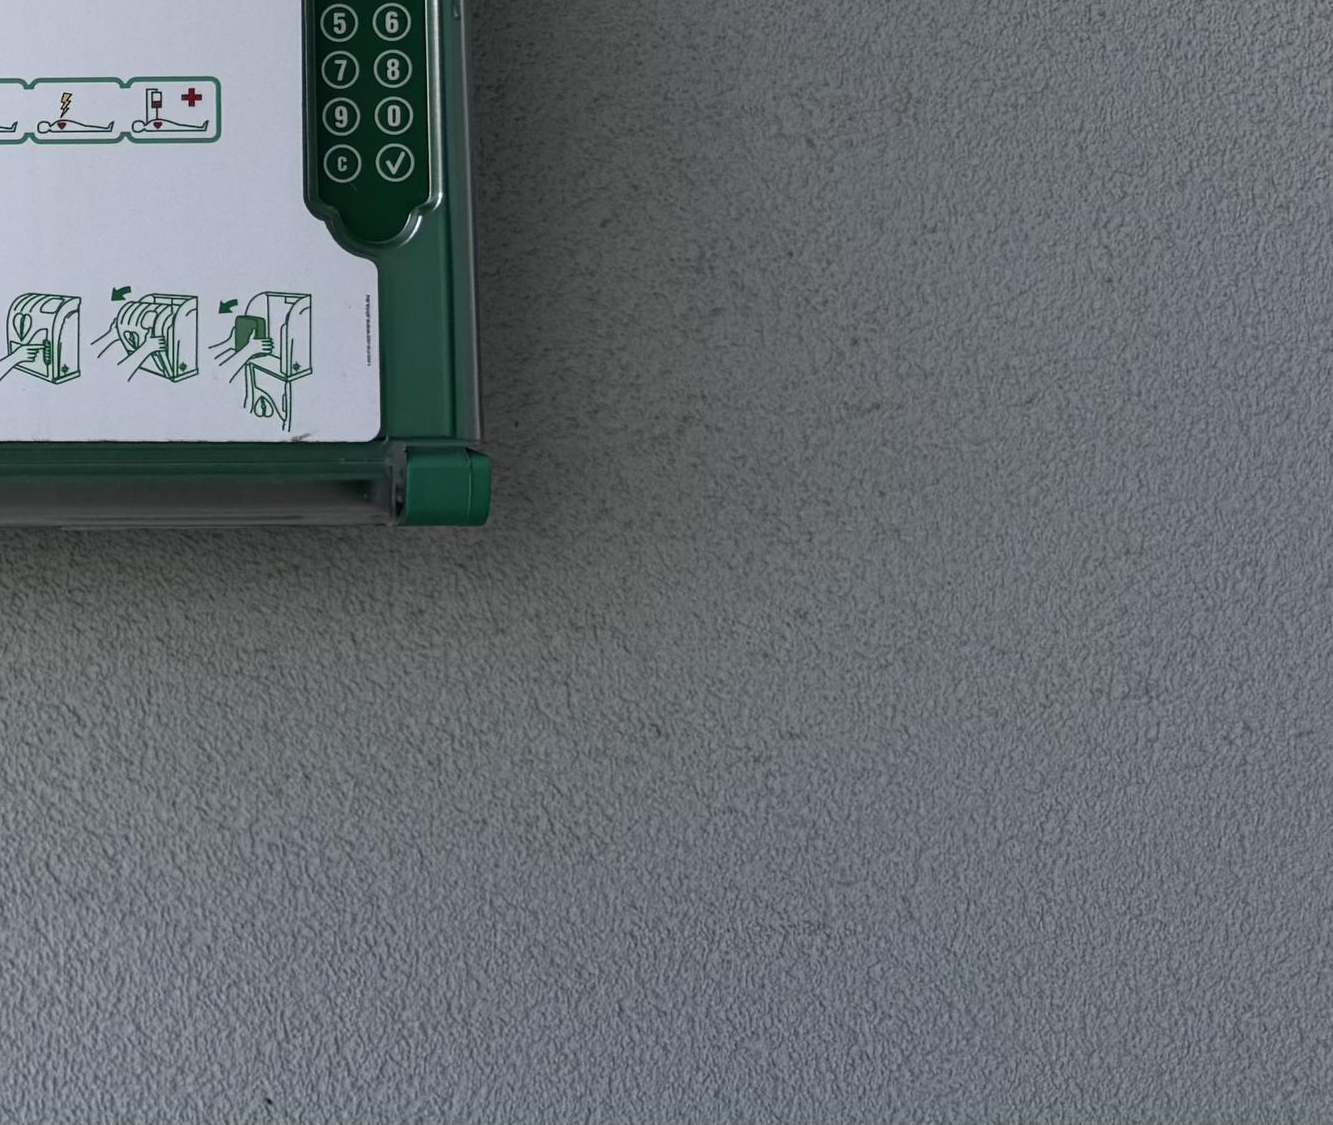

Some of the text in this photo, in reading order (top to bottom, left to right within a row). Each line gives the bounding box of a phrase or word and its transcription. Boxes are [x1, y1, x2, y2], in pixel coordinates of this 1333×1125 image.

[333, 11, 399, 35] 5 6
[334, 58, 400, 81] 7 8
[335, 105, 401, 129] 9 0
